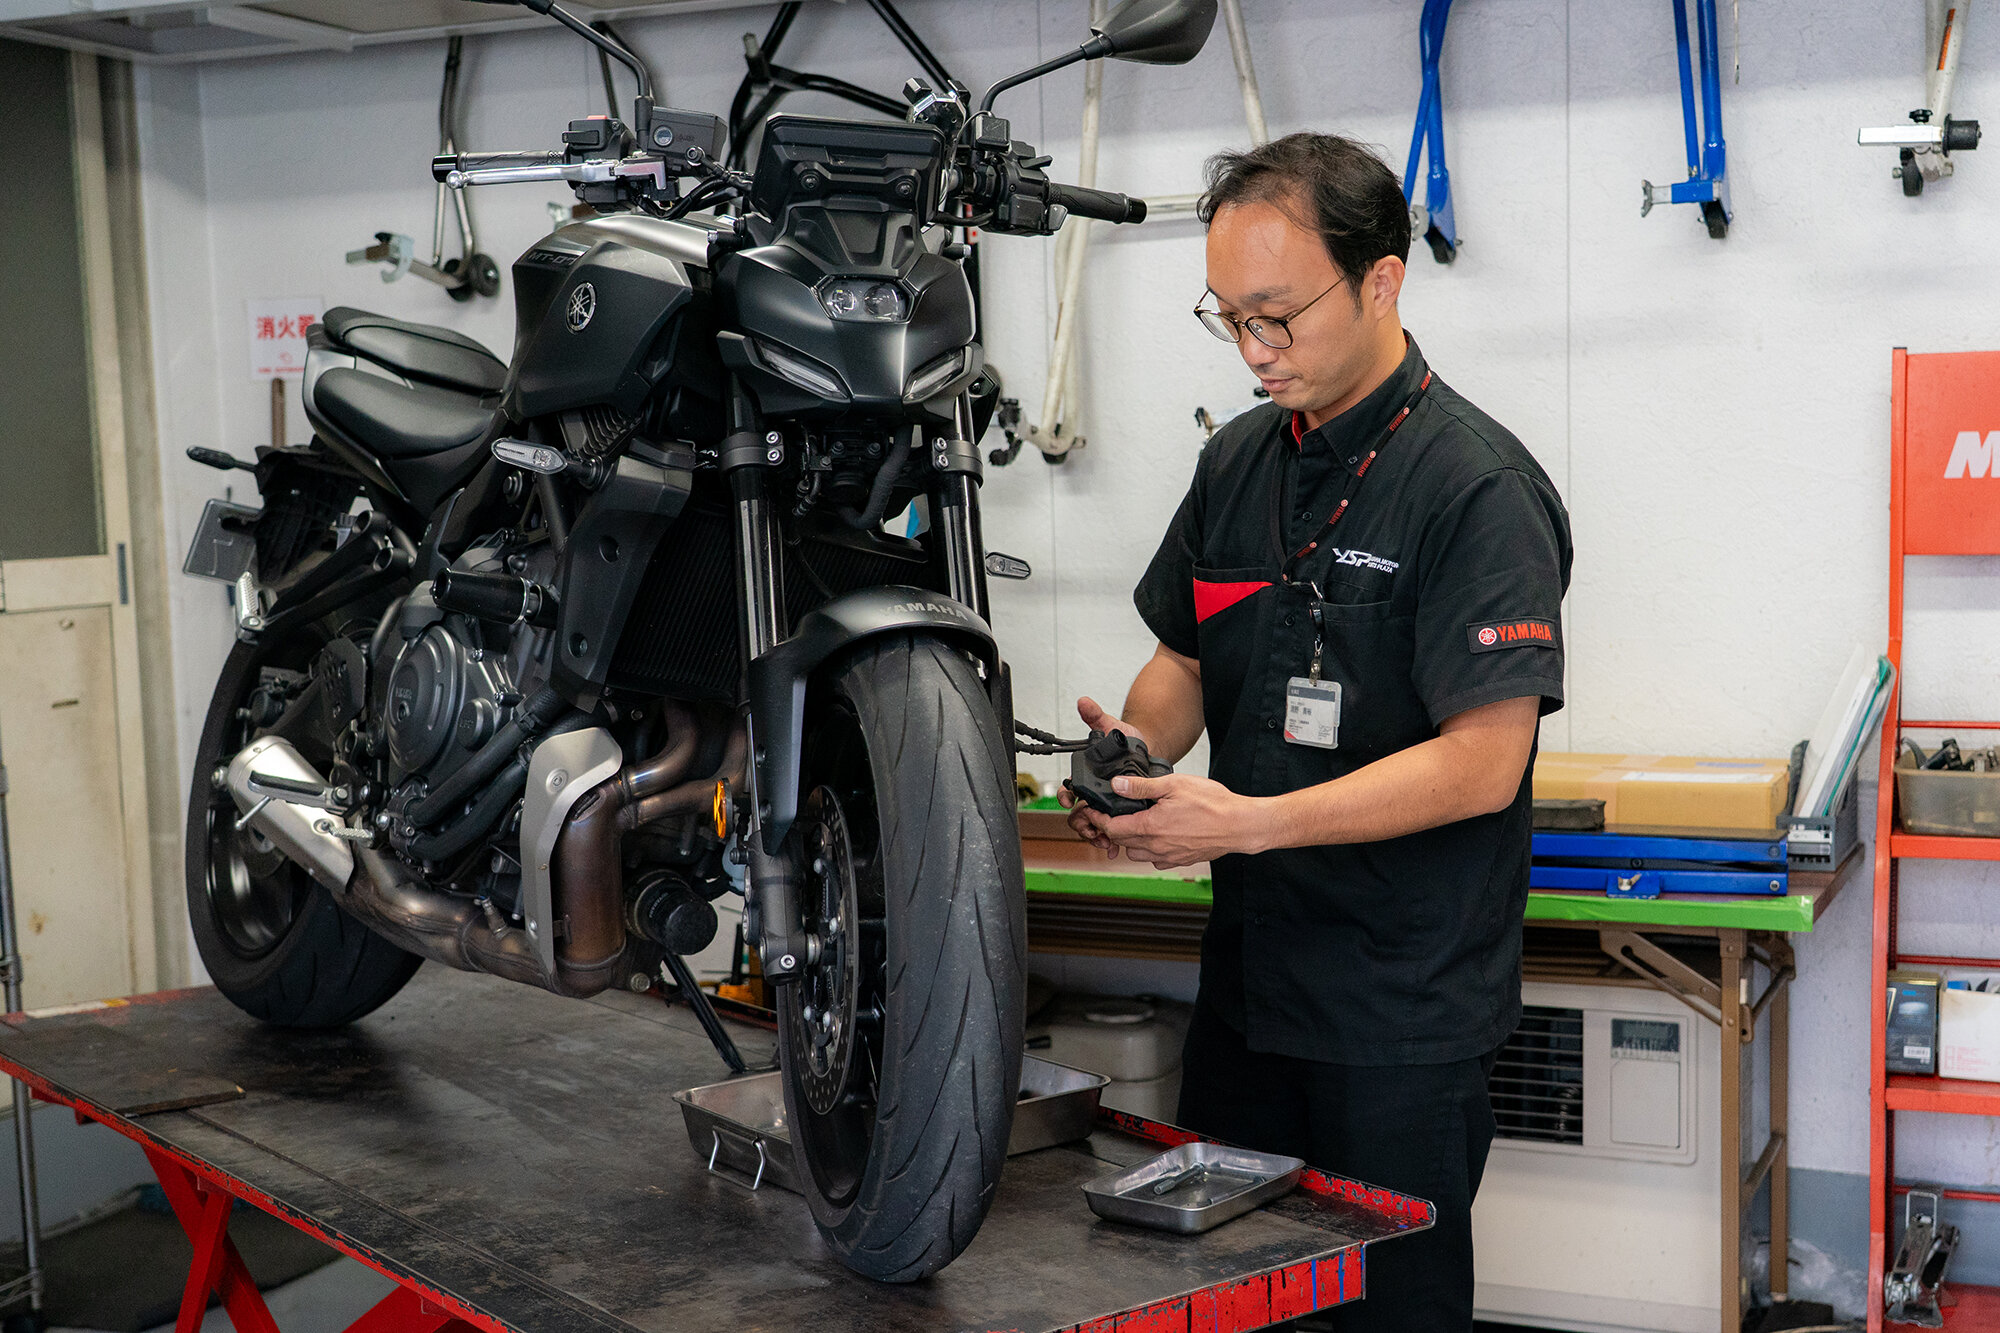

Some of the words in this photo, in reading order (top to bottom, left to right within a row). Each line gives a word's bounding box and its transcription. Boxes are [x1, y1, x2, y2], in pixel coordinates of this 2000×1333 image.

[1332, 548, 1372, 567] YSP
[880, 602, 969, 622] YAMAHA
[1496, 623, 1552, 642] YAMAHA
